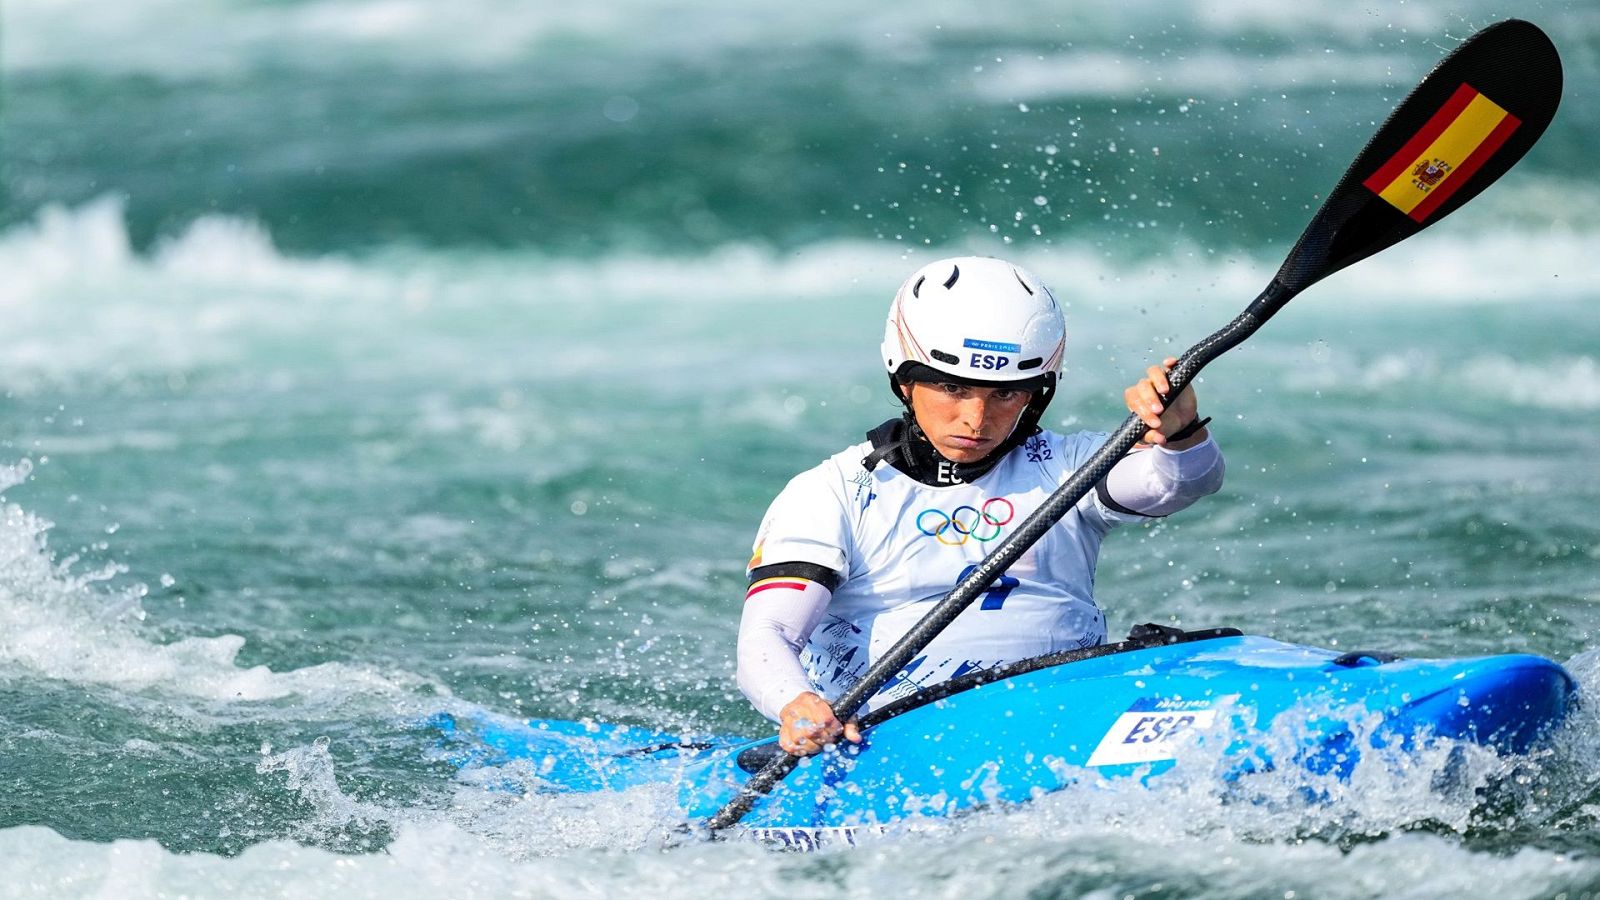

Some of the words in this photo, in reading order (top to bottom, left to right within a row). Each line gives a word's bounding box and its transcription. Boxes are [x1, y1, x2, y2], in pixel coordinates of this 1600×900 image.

[969, 353, 1010, 371] ESP
[964, 564, 991, 588] PARIS
[990, 543, 1015, 567] 2024
[1121, 716, 1196, 745] ESP
